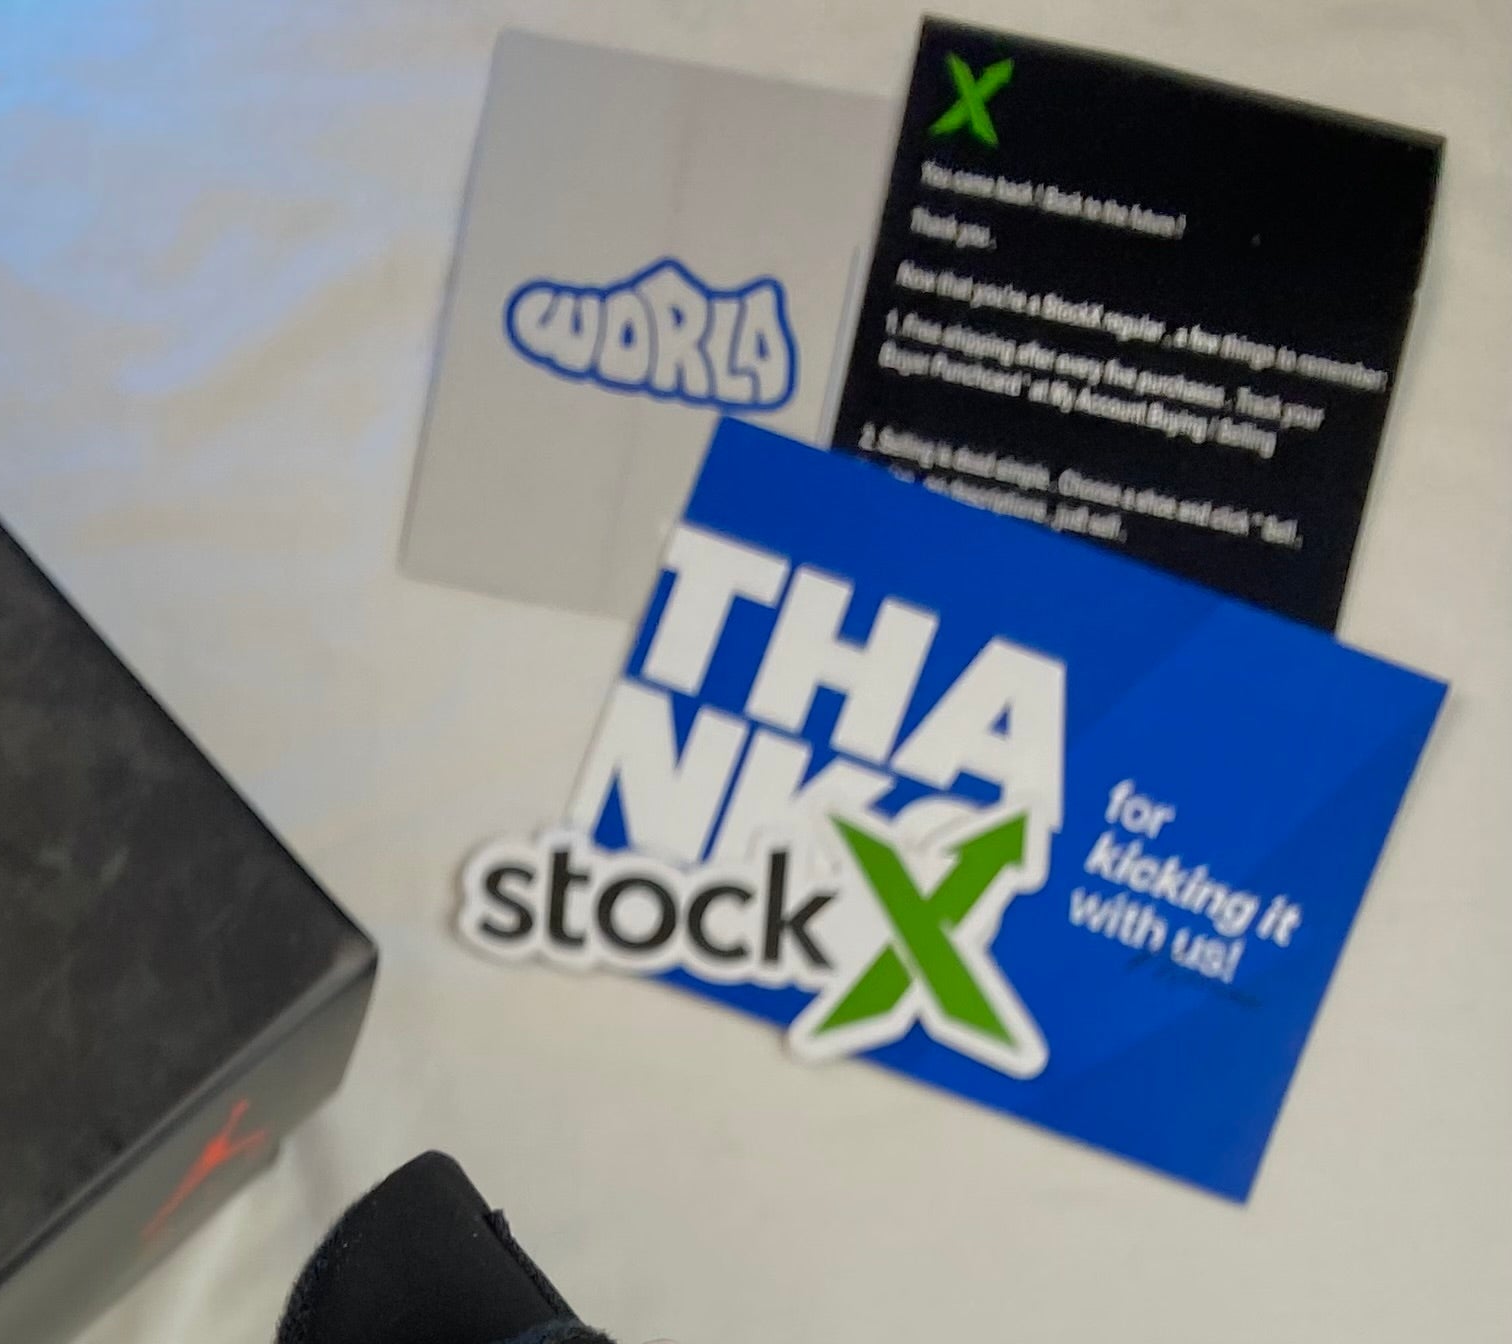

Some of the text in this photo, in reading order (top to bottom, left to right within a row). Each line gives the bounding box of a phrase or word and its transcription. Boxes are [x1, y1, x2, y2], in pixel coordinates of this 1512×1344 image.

[505, 257, 798, 412] WORLD
[641, 523, 1065, 833] THA
[1107, 780, 1174, 838] for
[481, 811, 1029, 1049] stockX
[1070, 888, 1245, 983] with us!
[1085, 832, 1301, 946] kicking it
